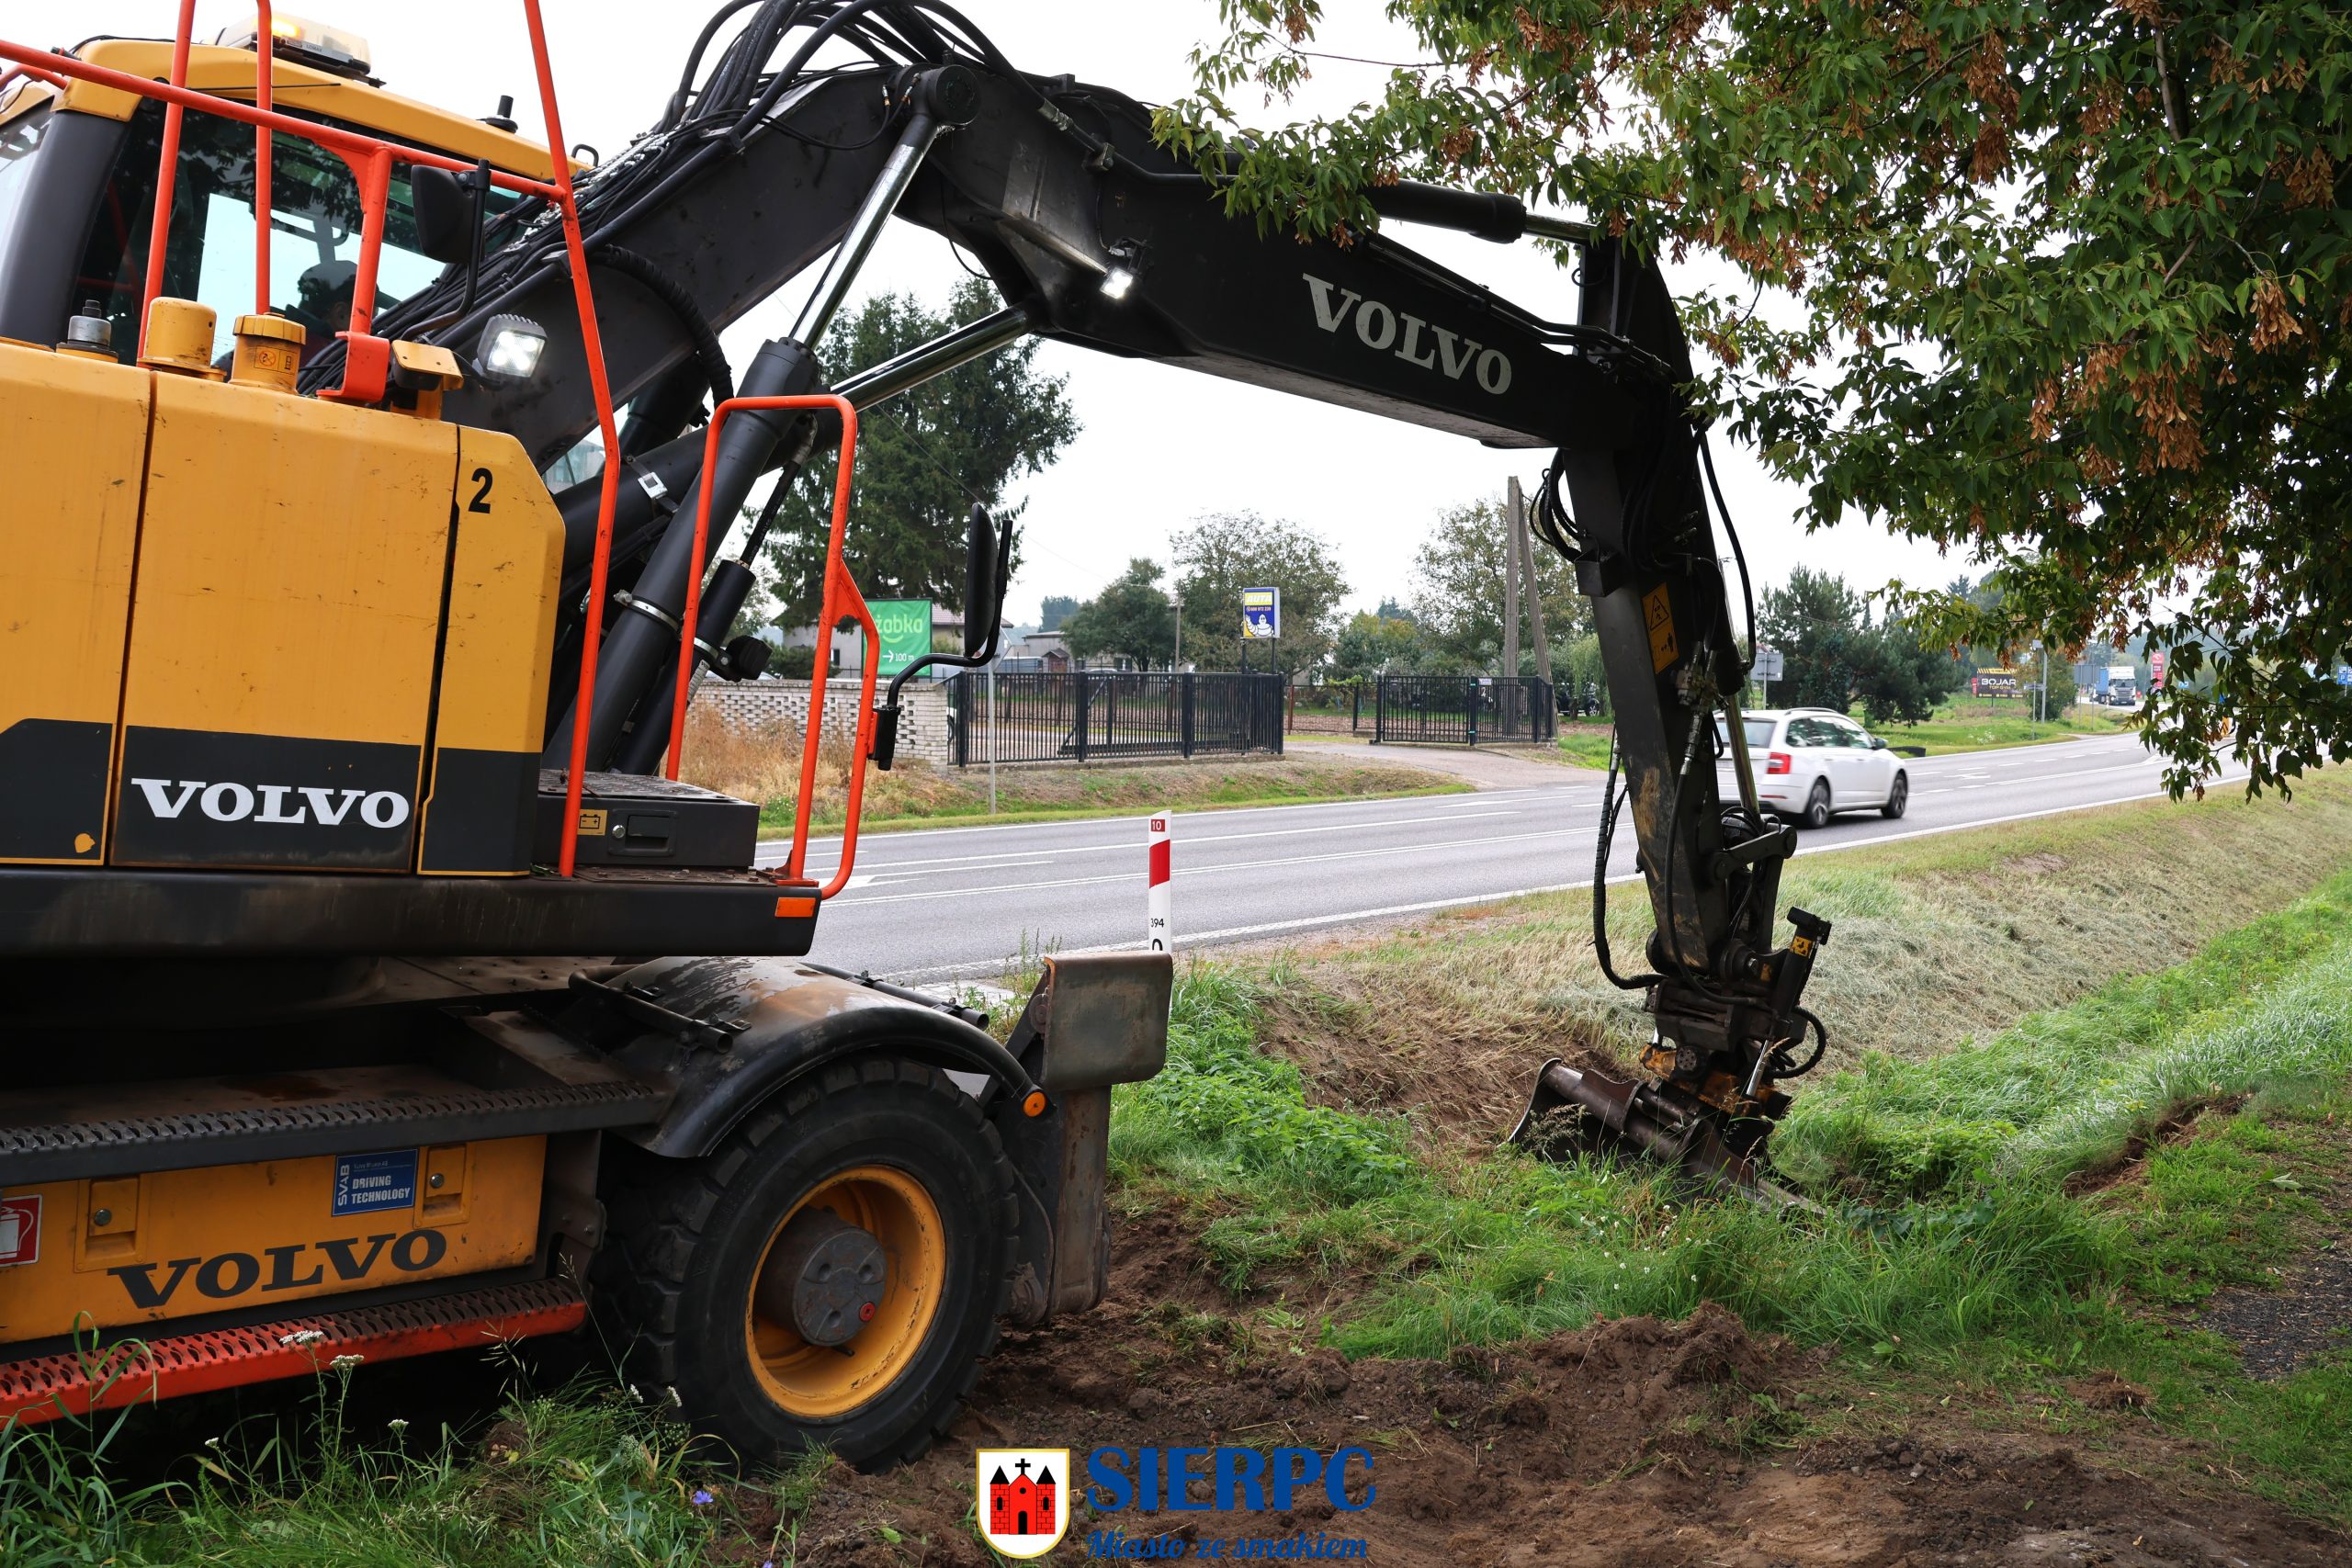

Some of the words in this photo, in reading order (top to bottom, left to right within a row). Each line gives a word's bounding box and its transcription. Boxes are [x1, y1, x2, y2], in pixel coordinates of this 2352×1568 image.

[1302, 272, 1512, 395] VOLVO
[468, 468, 493, 514] 2
[895, 653, 907, 662] 100
[1981, 678, 2017, 686] BOJAR
[131, 778, 410, 829] VOLVO
[1152, 820, 1162, 830] 10
[1150, 918, 1165, 928] 394
[337, 1164, 350, 1206] SVAB
[352, 1175, 391, 1190] DRIVING
[351, 1187, 411, 1204] TECHNOLOGY
[107, 1229, 447, 1309] VOLVO
